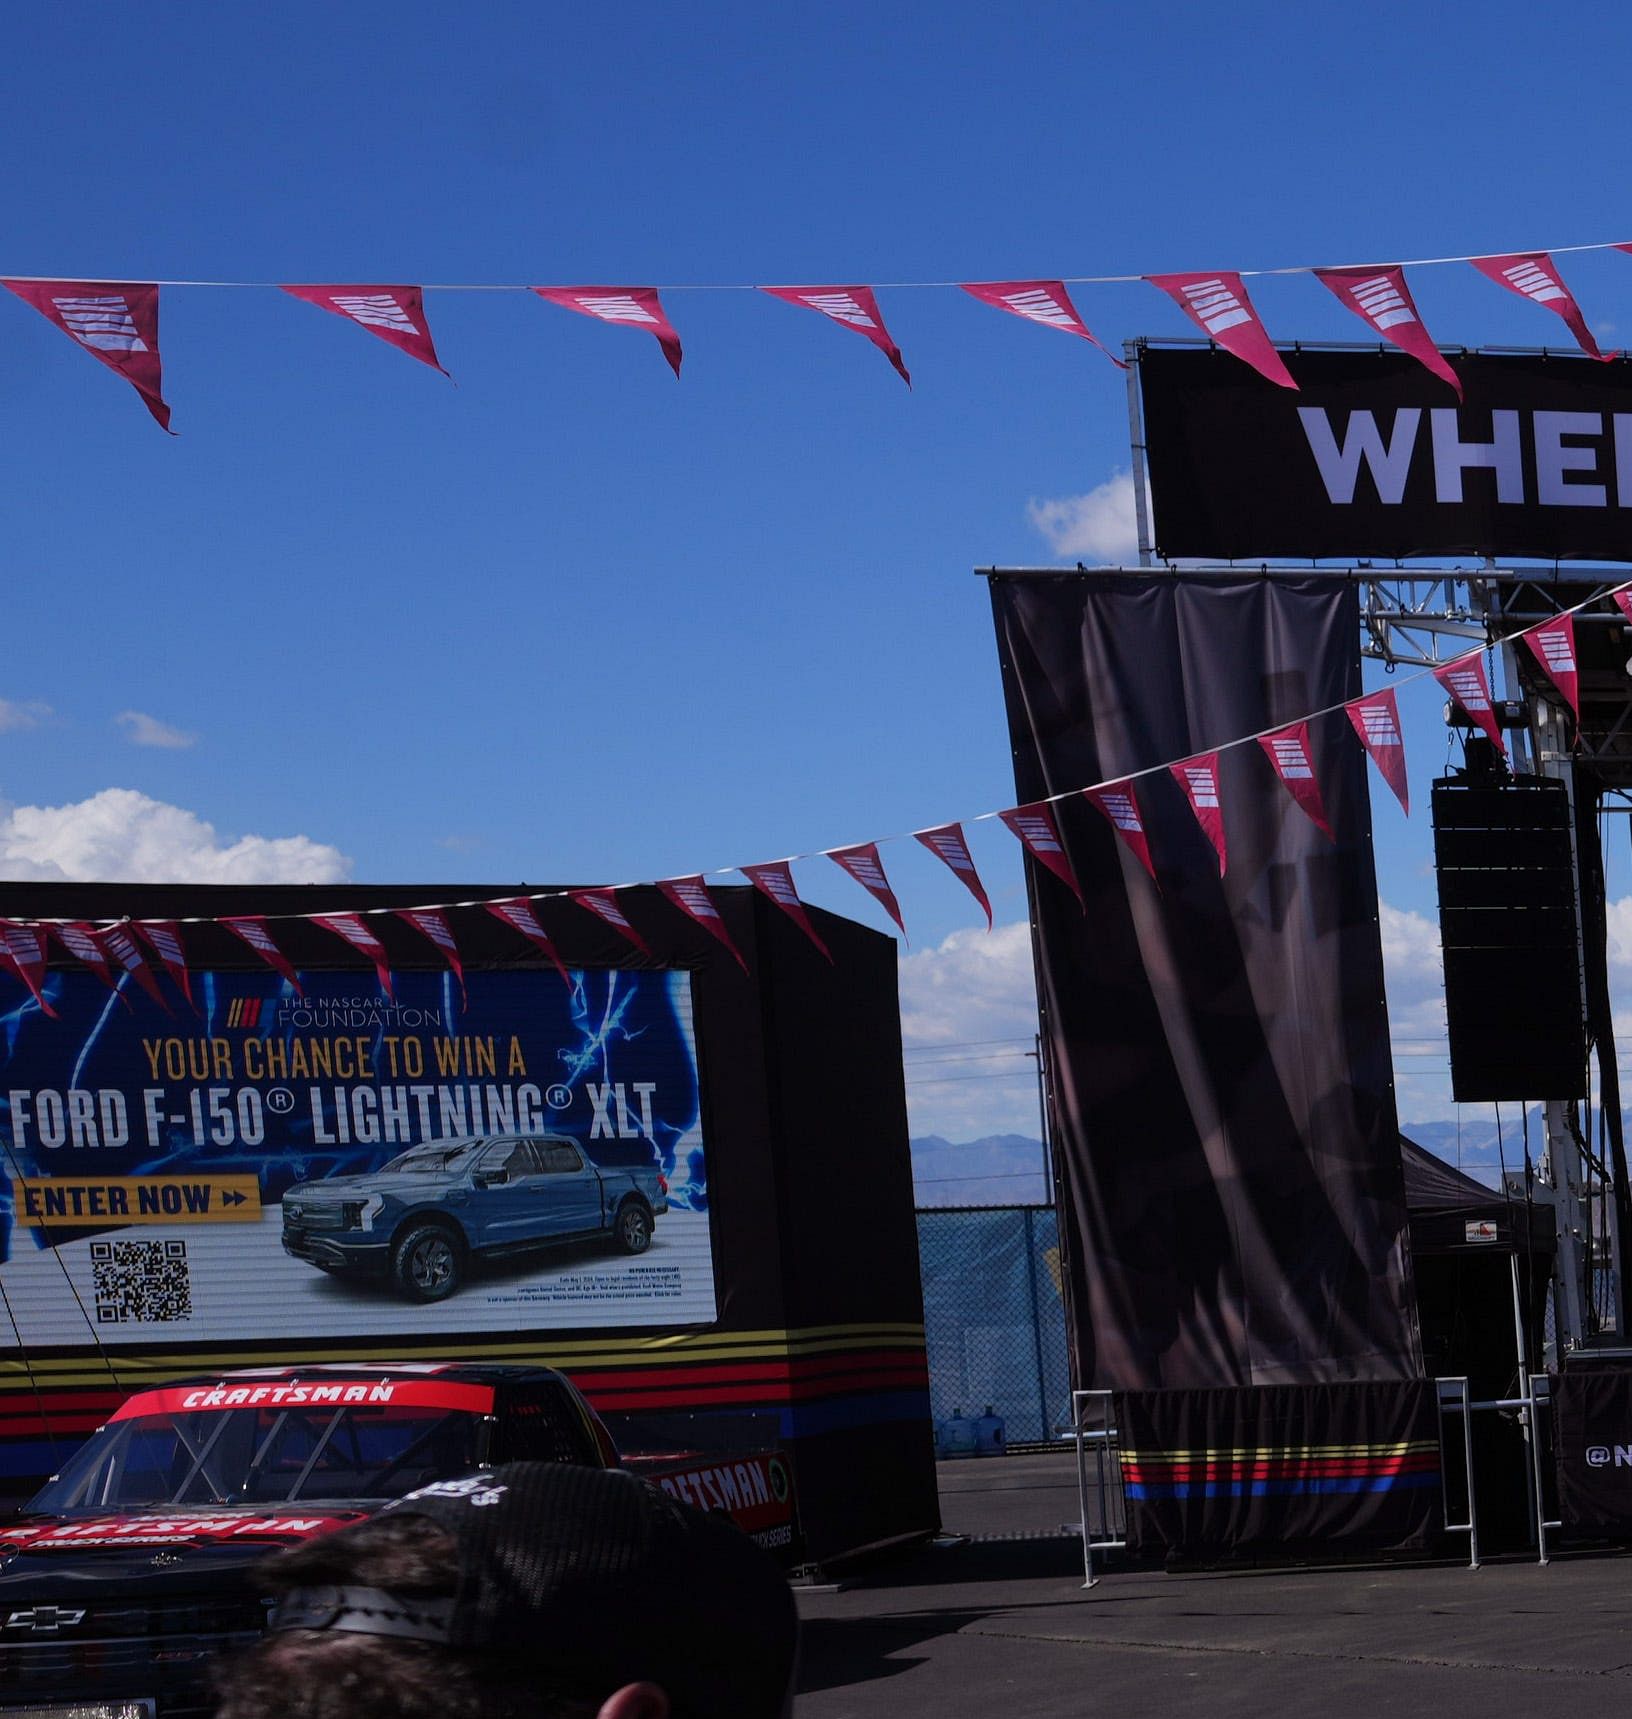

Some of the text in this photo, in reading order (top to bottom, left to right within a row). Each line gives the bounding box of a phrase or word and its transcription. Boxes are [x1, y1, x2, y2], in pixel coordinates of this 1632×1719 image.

[283, 998, 382, 1009] THE NASCAR
[278, 1009, 441, 1029] FOUNDATION
[142, 1034, 527, 1082] YOUR CHANCE TO WIN A
[8, 1087, 129, 1149] FORD
[584, 1082, 657, 1139] XLT
[25, 1184, 212, 1217] ENTER NOW
[182, 1385, 395, 1408] CRAFTSMAN
